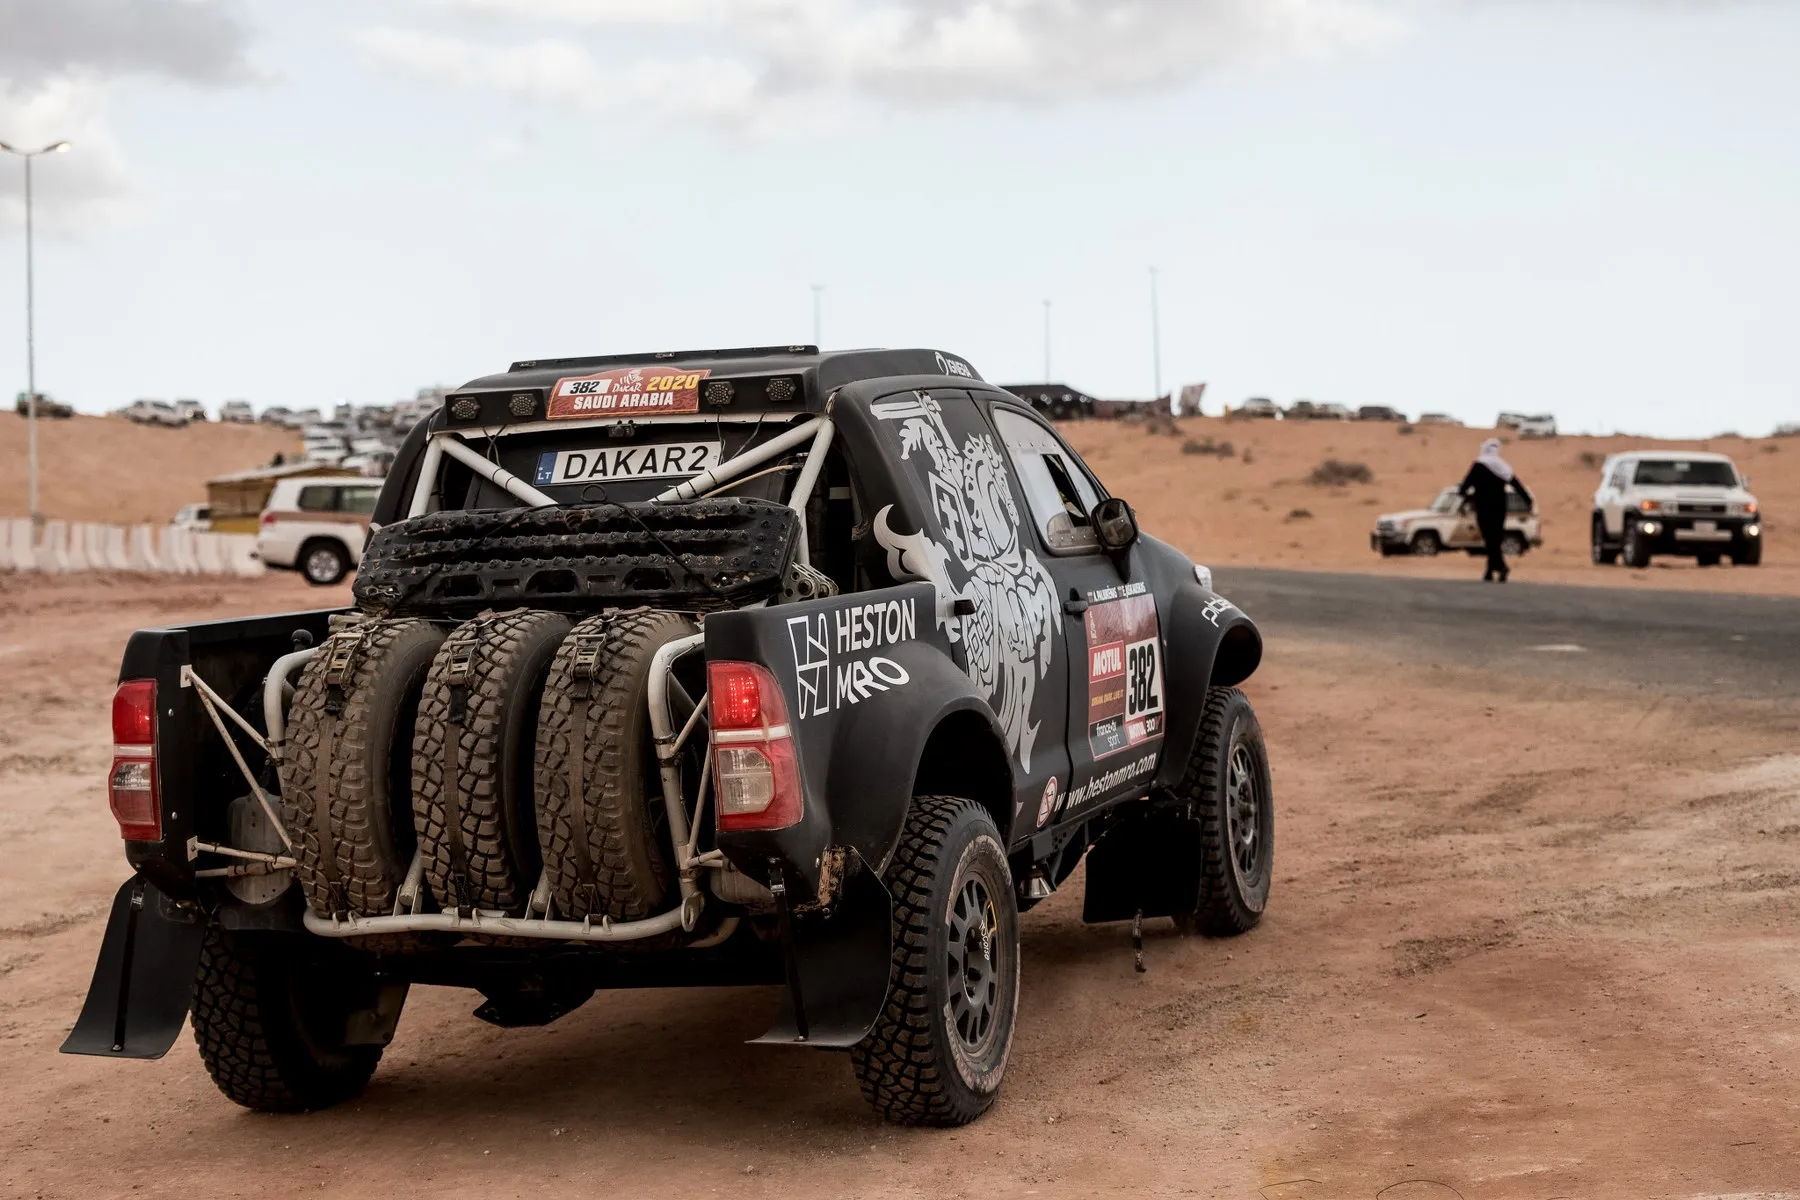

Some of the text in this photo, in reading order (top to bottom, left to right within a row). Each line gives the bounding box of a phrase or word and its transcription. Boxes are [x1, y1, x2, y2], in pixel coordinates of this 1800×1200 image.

[570, 374, 700, 394] 382 DAKAR 2020
[573, 392, 674, 410] SAUDI ARABIA
[538, 445, 709, 480] LT DAKAR2
[835, 598, 916, 654] HESTON
[1093, 647, 1122, 677] MOTUL
[1129, 643, 1159, 715] 382
[836, 657, 910, 709] MRO
[1107, 733, 1121, 750] sport
[1054, 752, 1157, 812] www.hestonmro.com
